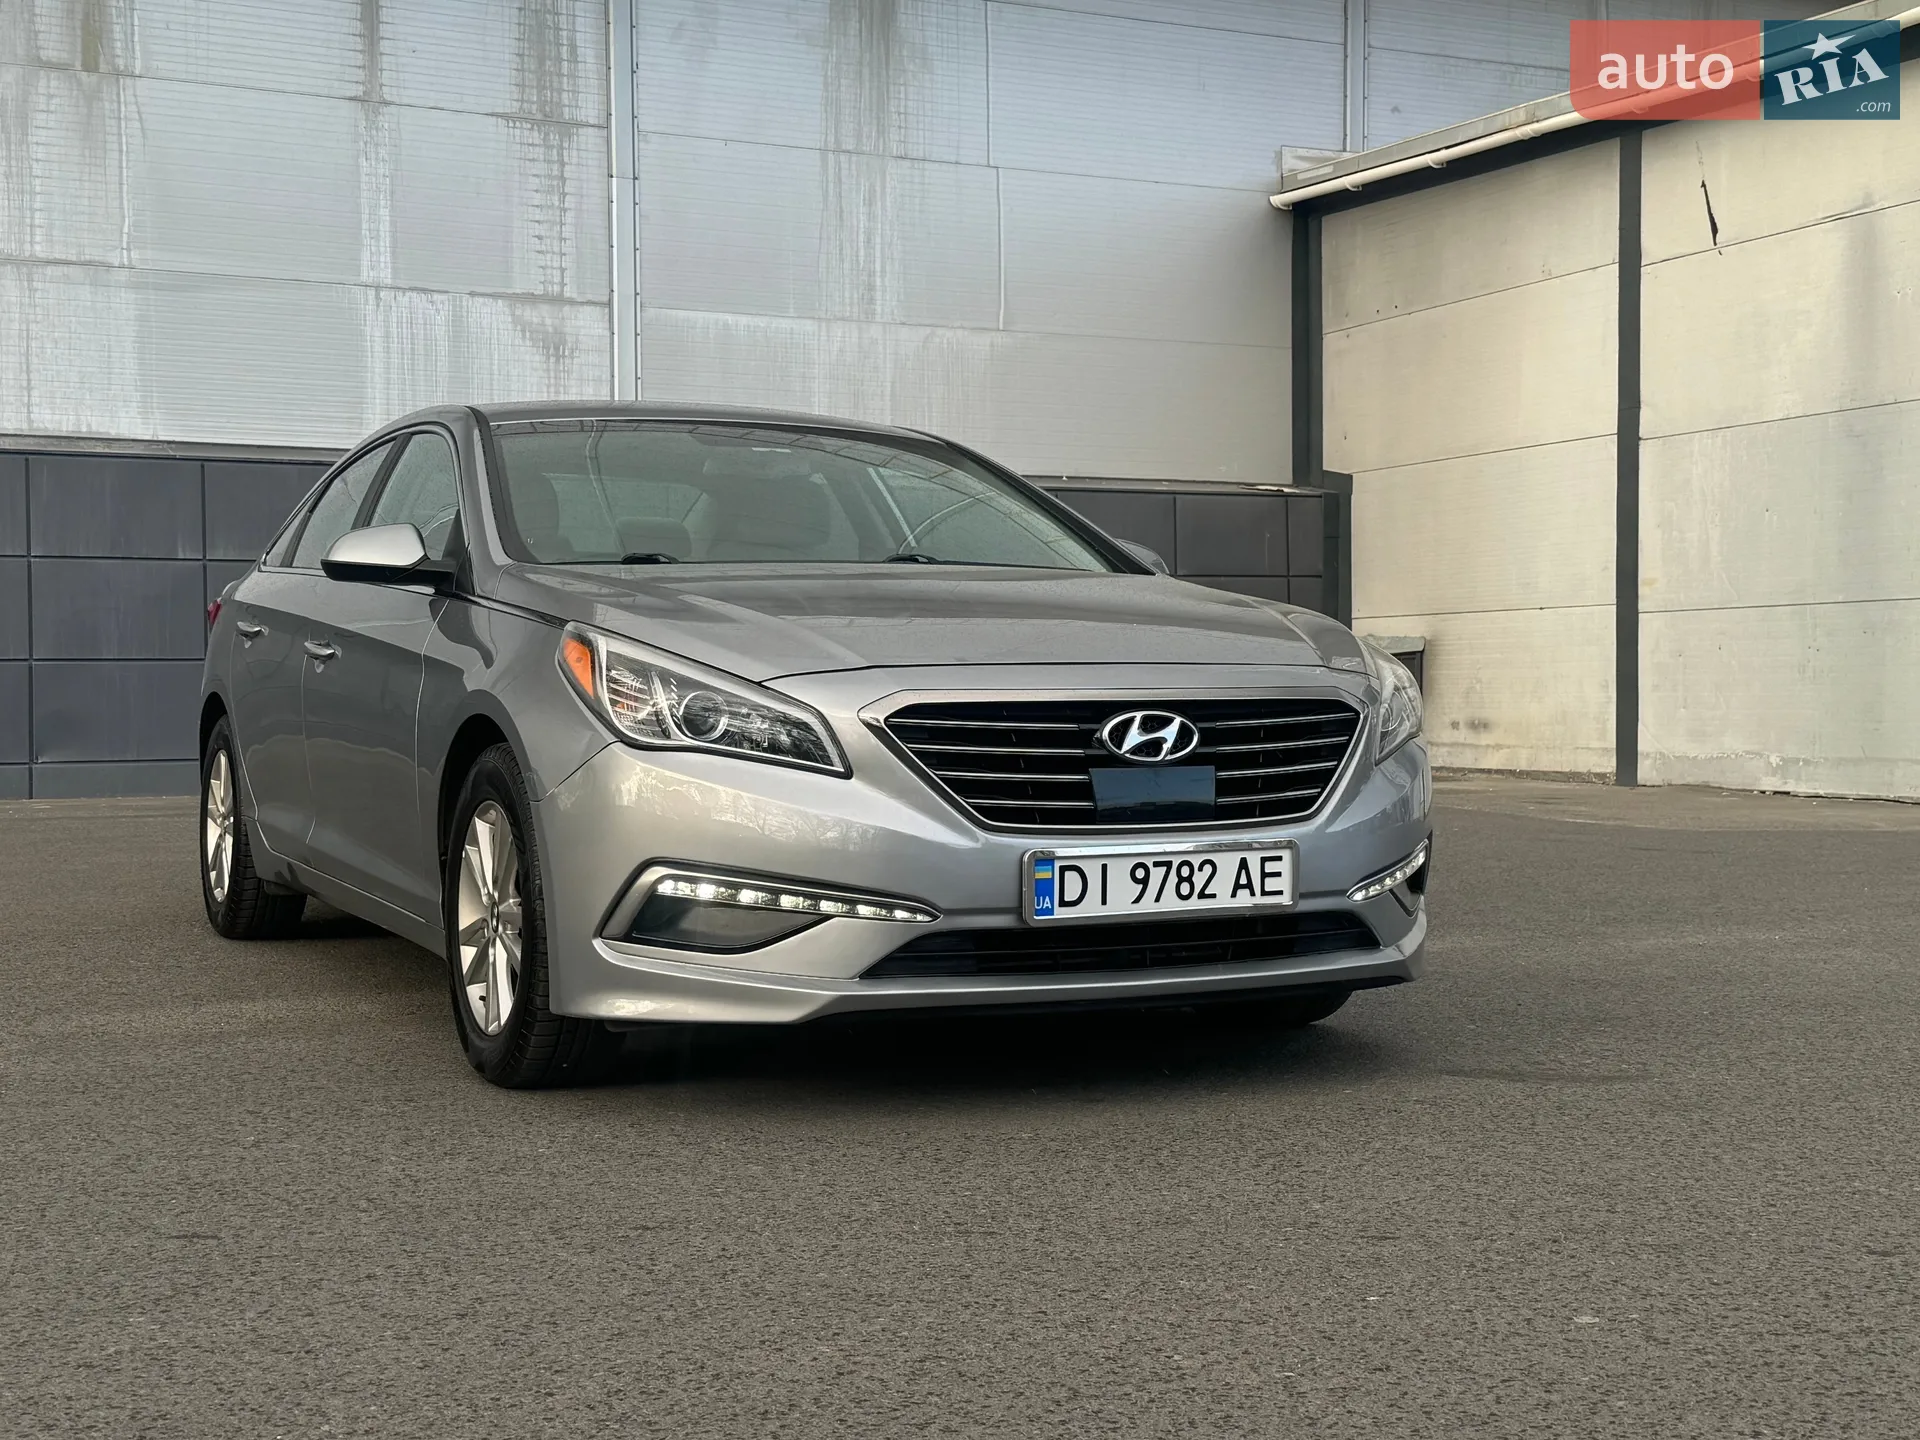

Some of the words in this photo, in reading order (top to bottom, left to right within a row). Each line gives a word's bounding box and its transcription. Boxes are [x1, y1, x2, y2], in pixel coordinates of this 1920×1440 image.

[1058, 863, 1108, 907] DI
[1129, 859, 1218, 904] 9782
[1230, 855, 1284, 899] AE
[1034, 896, 1052, 910] UA
